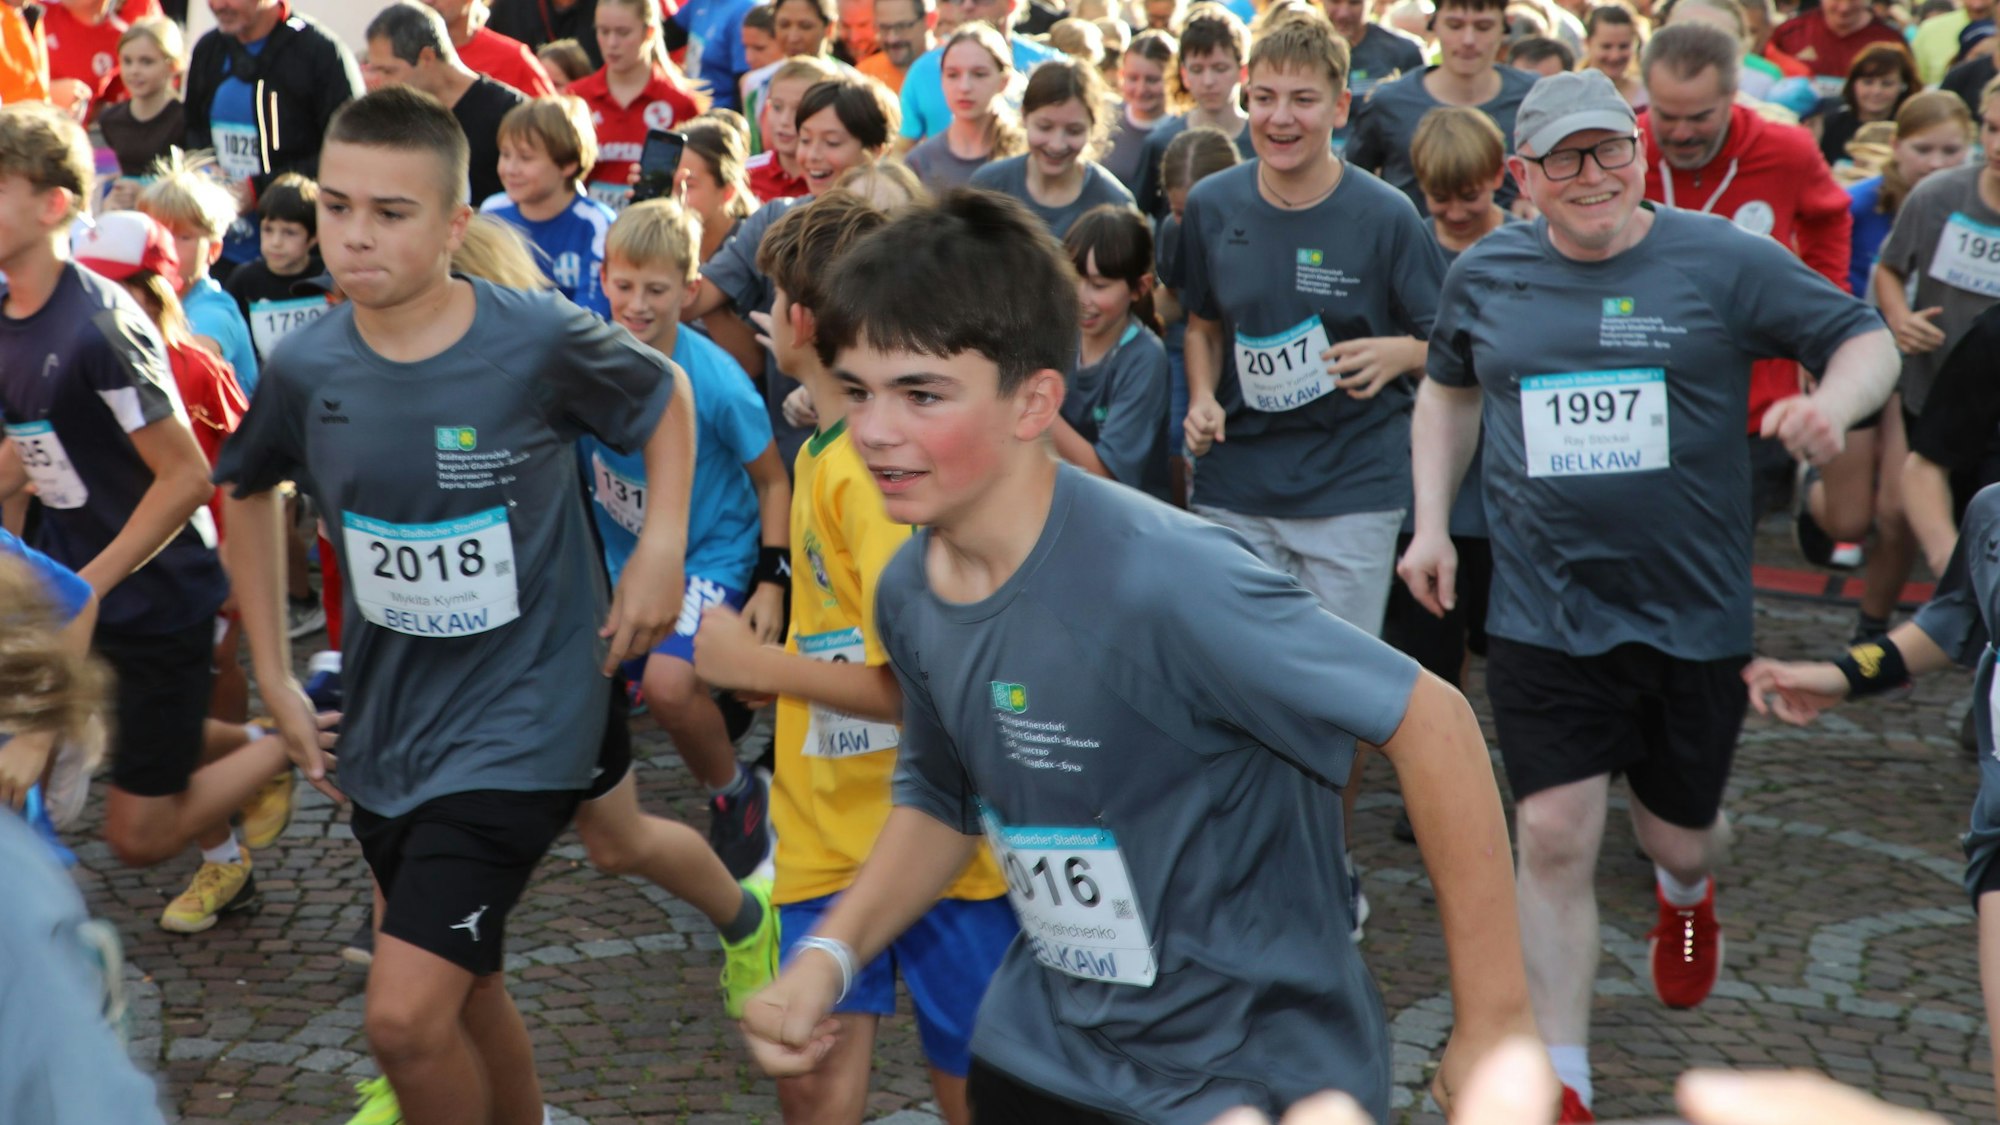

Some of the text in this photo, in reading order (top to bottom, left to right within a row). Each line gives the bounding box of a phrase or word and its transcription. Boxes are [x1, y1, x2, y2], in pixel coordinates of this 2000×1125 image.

[1244, 337, 1308, 376] 2017
[1257, 381, 1321, 410] BELKAW
[1546, 388, 1641, 426] 1997
[1551, 449, 1642, 473] BELKAW
[370, 538, 486, 583] 2018
[389, 590, 480, 608] Mykita Kymlik
[383, 606, 489, 634] BELKAW
[1023, 731, 1061, 744] Gladbach
[1065, 737, 1100, 749] Butscha
[1061, 761, 1083, 773] Буча
[1053, 834, 1098, 845] Stadtlauf
